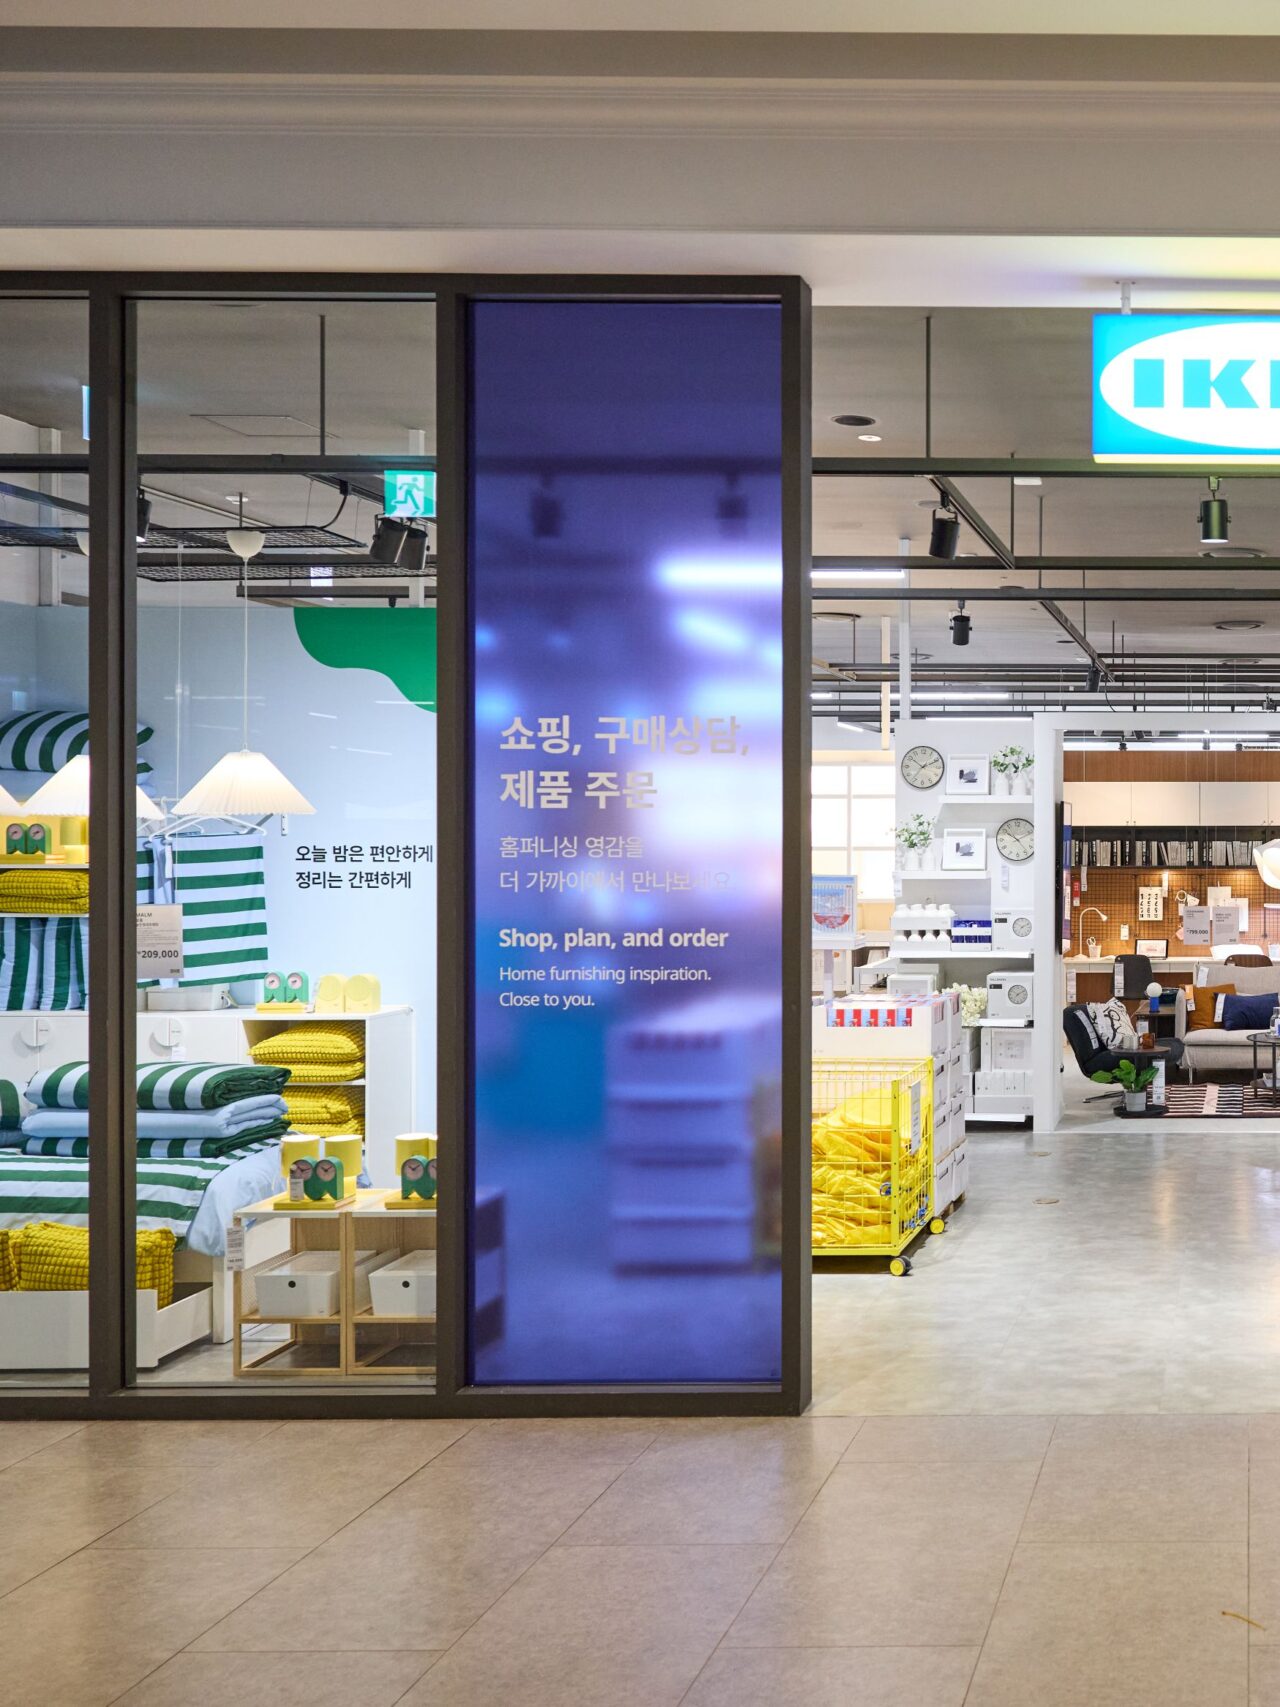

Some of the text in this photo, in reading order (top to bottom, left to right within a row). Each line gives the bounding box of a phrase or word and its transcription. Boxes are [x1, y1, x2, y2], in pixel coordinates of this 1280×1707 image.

[499, 715, 749, 756] 쇼핑, 구매상담,
[499, 769, 658, 809] 제품 주문
[295, 845, 433, 863] 오늘 밤은 편안하게
[499, 836, 644, 858] 홈퍼니싱 영감을
[295, 871, 411, 889] 정리는 간편하게
[500, 871, 518, 892] 더
[526, 871, 624, 892] 가까이에서
[499, 928, 729, 952] Shop, plan, and order
[499, 966, 712, 985] Home furnishing inspiration.
[499, 991, 595, 1010] Close to you.
